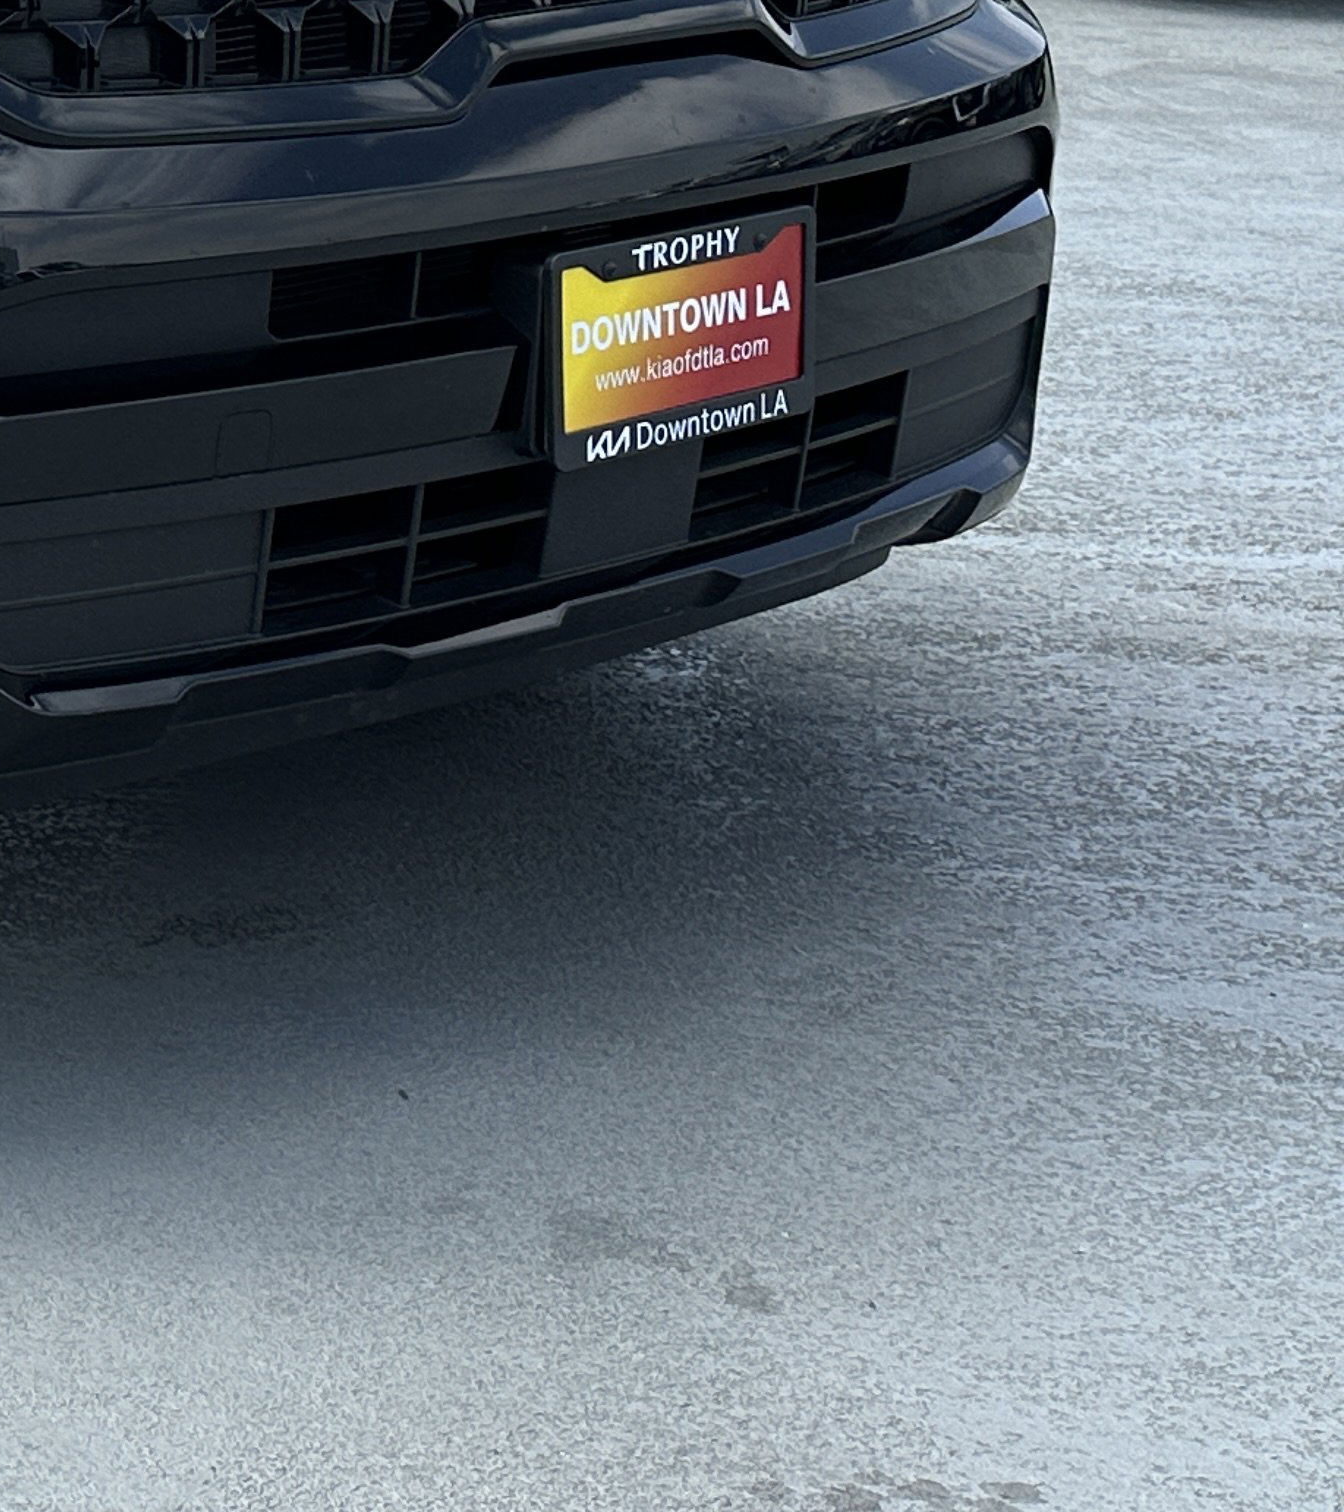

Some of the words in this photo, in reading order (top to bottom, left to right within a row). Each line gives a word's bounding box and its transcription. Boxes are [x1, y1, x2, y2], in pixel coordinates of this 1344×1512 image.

[632, 226, 739, 270] TROPHY
[570, 288, 746, 355] DOWNTOWN
[756, 280, 790, 317] LA
[595, 338, 769, 391] www.kiaofdtla.com
[586, 426, 631, 462] KIA
[637, 401, 755, 449] Downtown
[761, 389, 788, 419] LA
